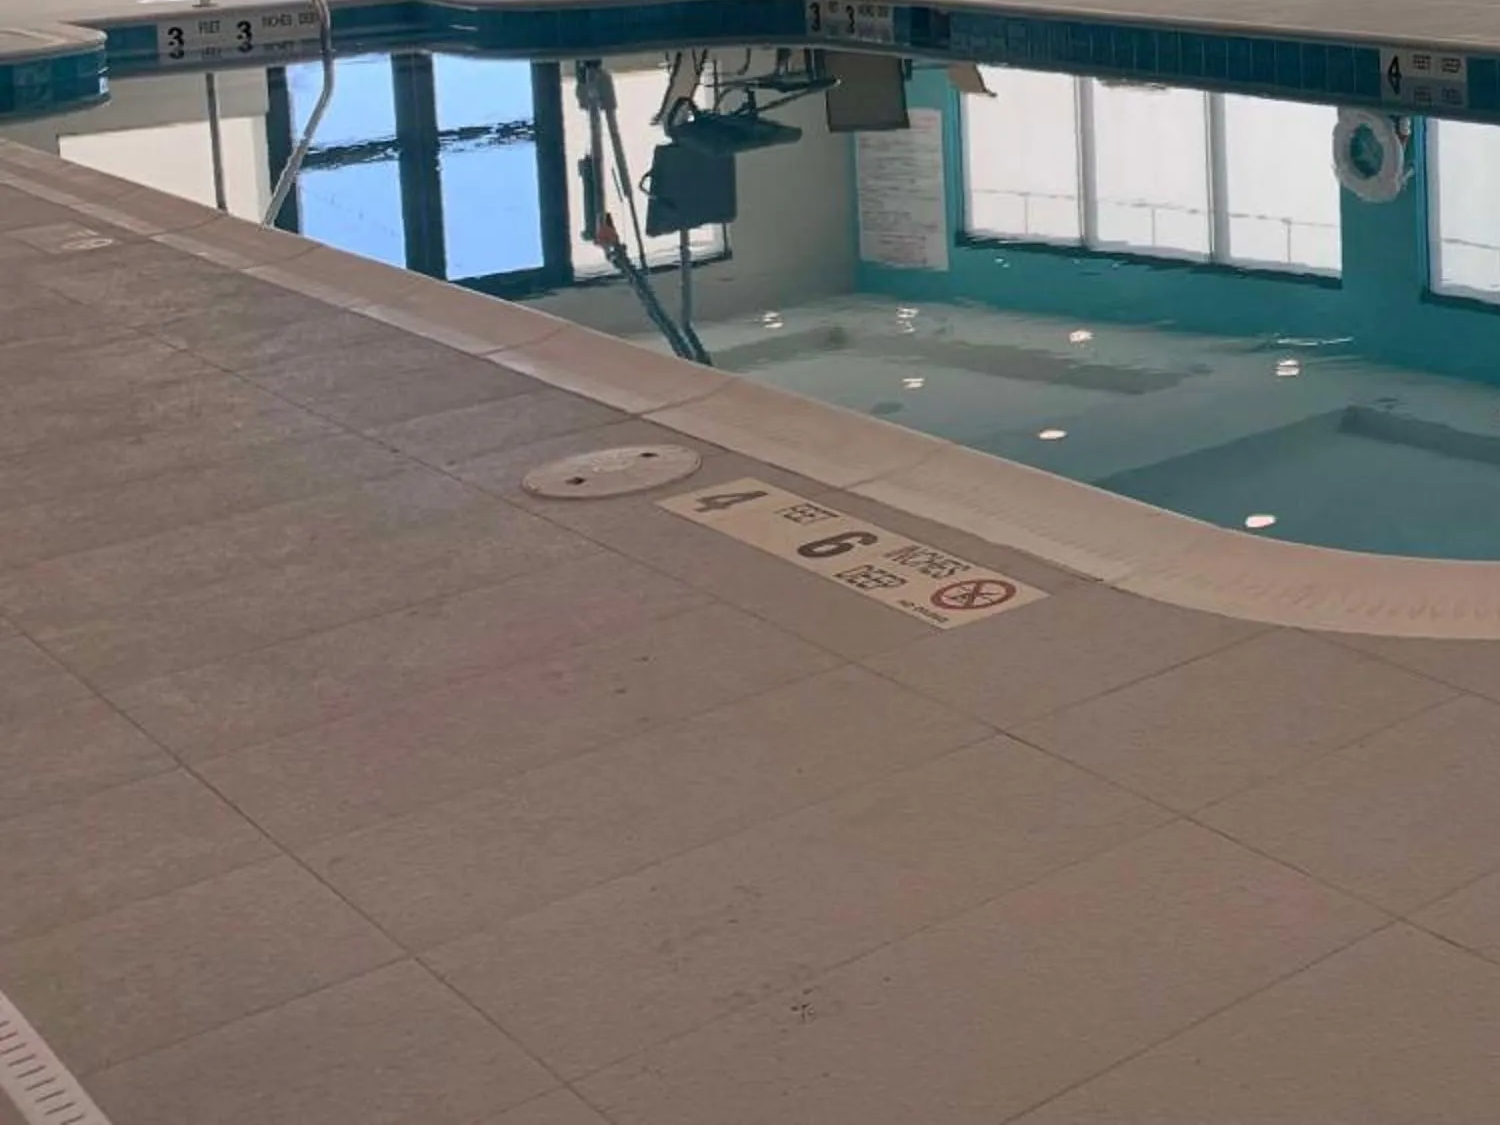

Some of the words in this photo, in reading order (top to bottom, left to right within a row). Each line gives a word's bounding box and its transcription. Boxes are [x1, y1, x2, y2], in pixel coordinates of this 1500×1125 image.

[695, 490, 769, 513] 4
[775, 503, 840, 525] FEET
[796, 530, 879, 559] 6
[833, 565, 907, 591] DEEP
